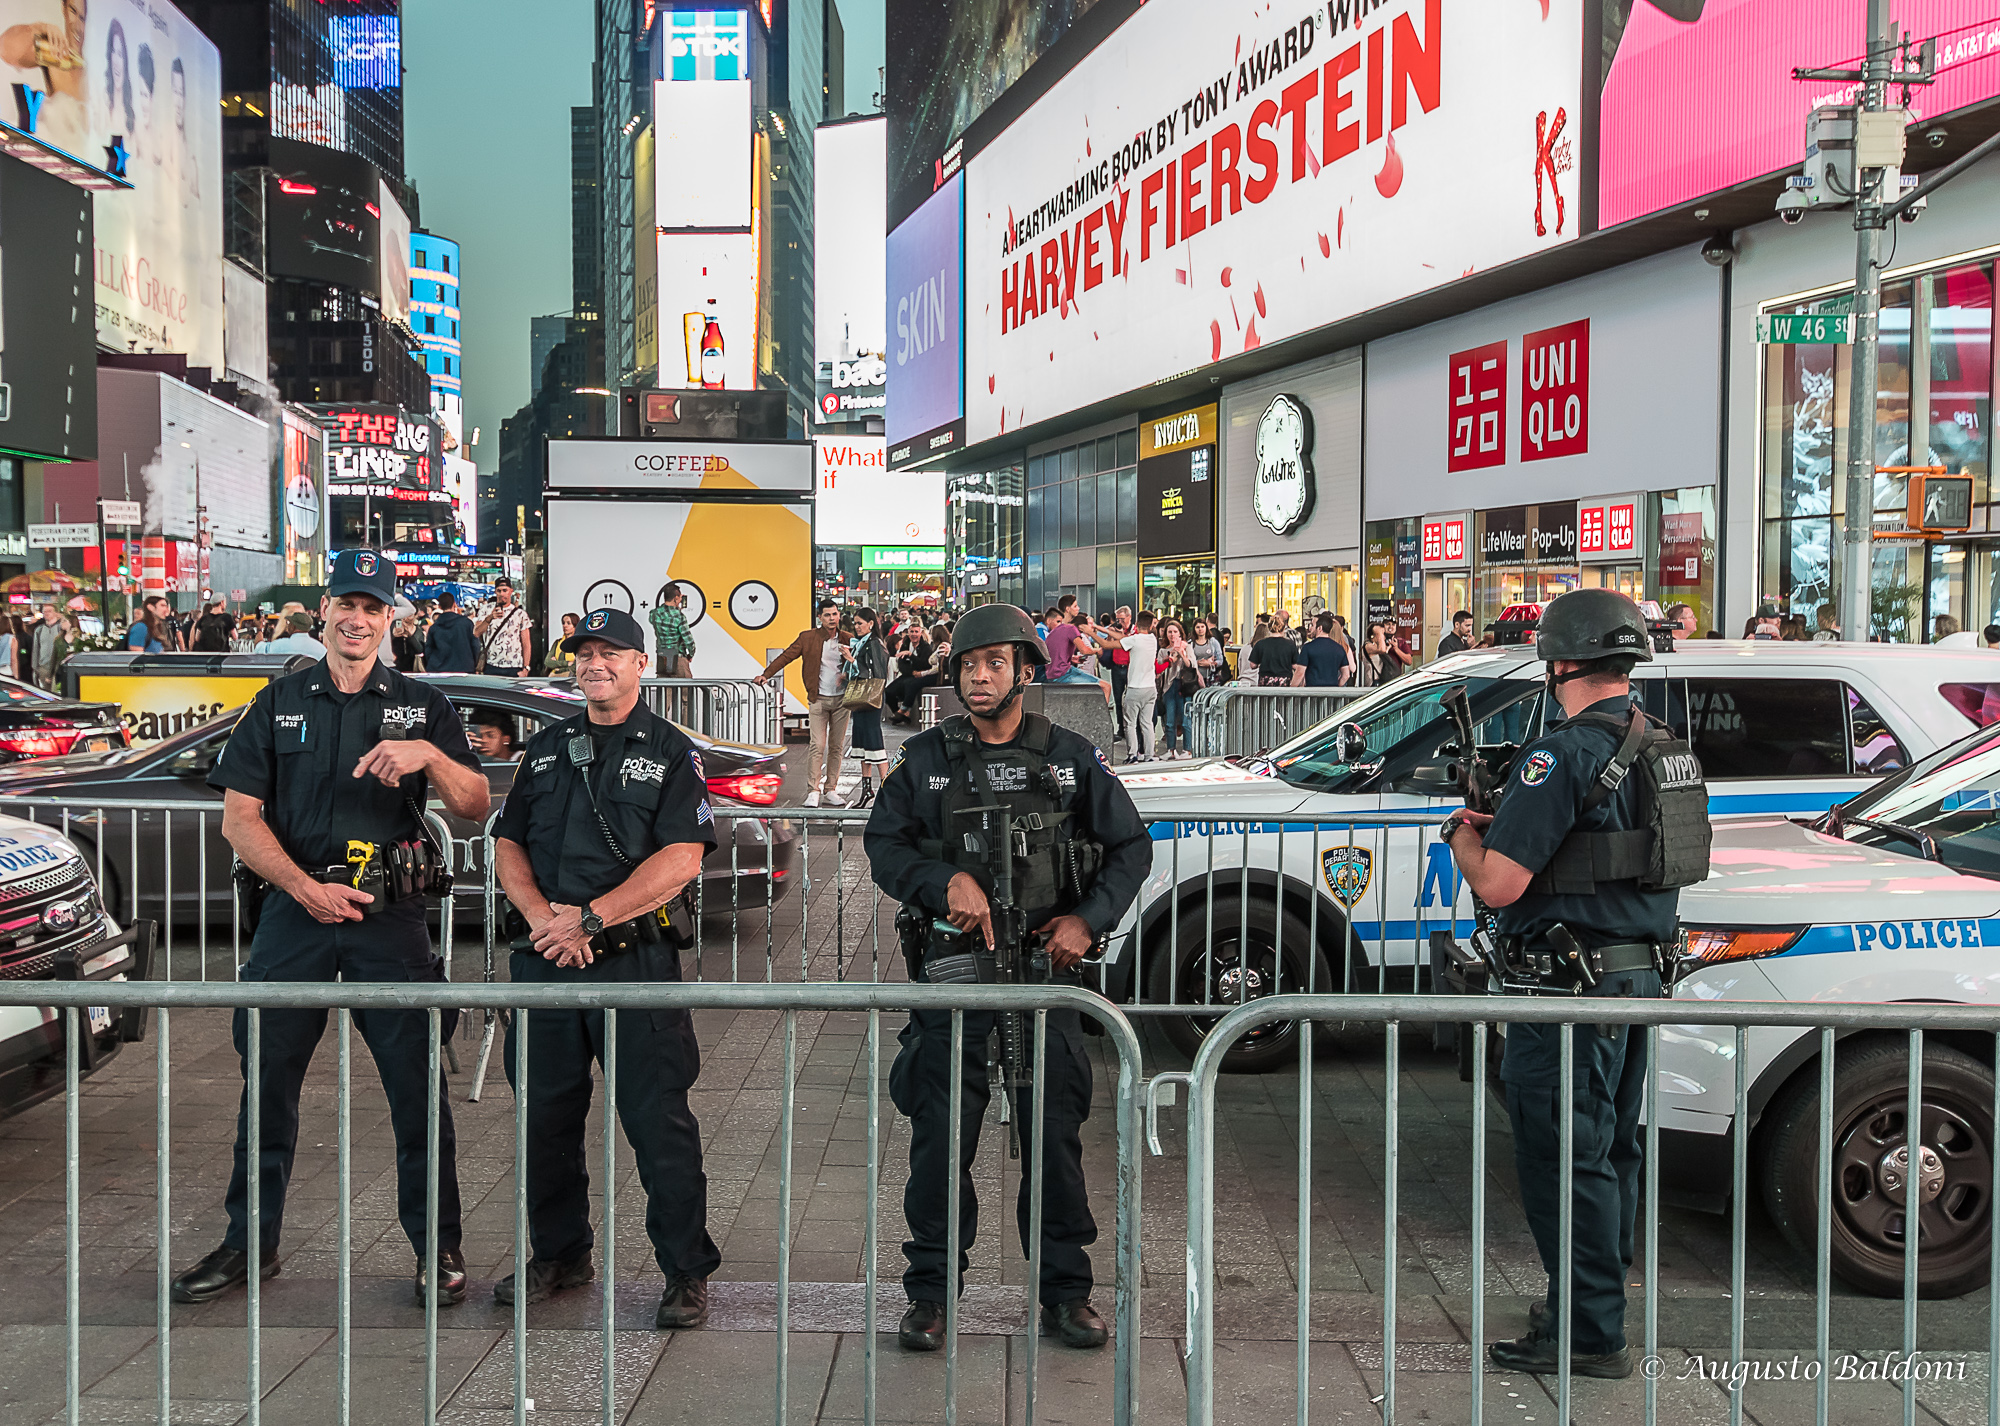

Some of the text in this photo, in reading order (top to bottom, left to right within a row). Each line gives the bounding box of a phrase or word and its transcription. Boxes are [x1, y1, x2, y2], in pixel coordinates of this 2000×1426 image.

[685, 37, 741, 57] TDK
[1955, 31, 1986, 64] AT&T
[1002, 0, 1441, 335] HARVEY FIERSTEIN
[1010, 164, 1108, 249] HEARTWARMING
[1112, 127, 1153, 184] BOOK
[1156, 109, 1180, 155] BY
[1182, 71, 1232, 137] TONY
[1792, 176, 1813, 186] NYPD
[896, 268, 946, 366] SKIN
[1774, 318, 1792, 340] W
[1801, 317, 1826, 341] 46
[363, 322, 373, 372] 1500
[1529, 338, 1577, 392] UNI
[1153, 413, 1200, 449] INVICTA
[1528, 394, 1581, 452] QLO
[634, 454, 730, 472] COFFEED
[823, 446, 885, 467] What
[824, 469, 838, 489] if
[1480, 525, 1575, 553] LifeWear Pop-Up
[1369, 555, 1390, 567] Snowing?
[1398, 554, 1418, 566] Sweaty?
[1398, 603, 1416, 616] Windy?
[1398, 617, 1418, 629] Raining?
[1619, 635, 1636, 643] SRG
[384, 708, 427, 721] POLICE
[538, 755, 557, 765] MARCO
[622, 758, 666, 777] POLICE
[1662, 754, 1698, 782] NYPD
[929, 782, 947, 791] 207
[1183, 821, 1263, 839] POLICE
[0, 844, 59, 876] OLICE
[1325, 854, 1369, 868] DEPARMENT
[1333, 849, 1360, 857] POLCE
[1326, 873, 1337, 889] CITY
[1361, 868, 1370, 886] YORK
[1335, 890, 1344, 898] OF
[1856, 919, 1980, 951] POLICE
